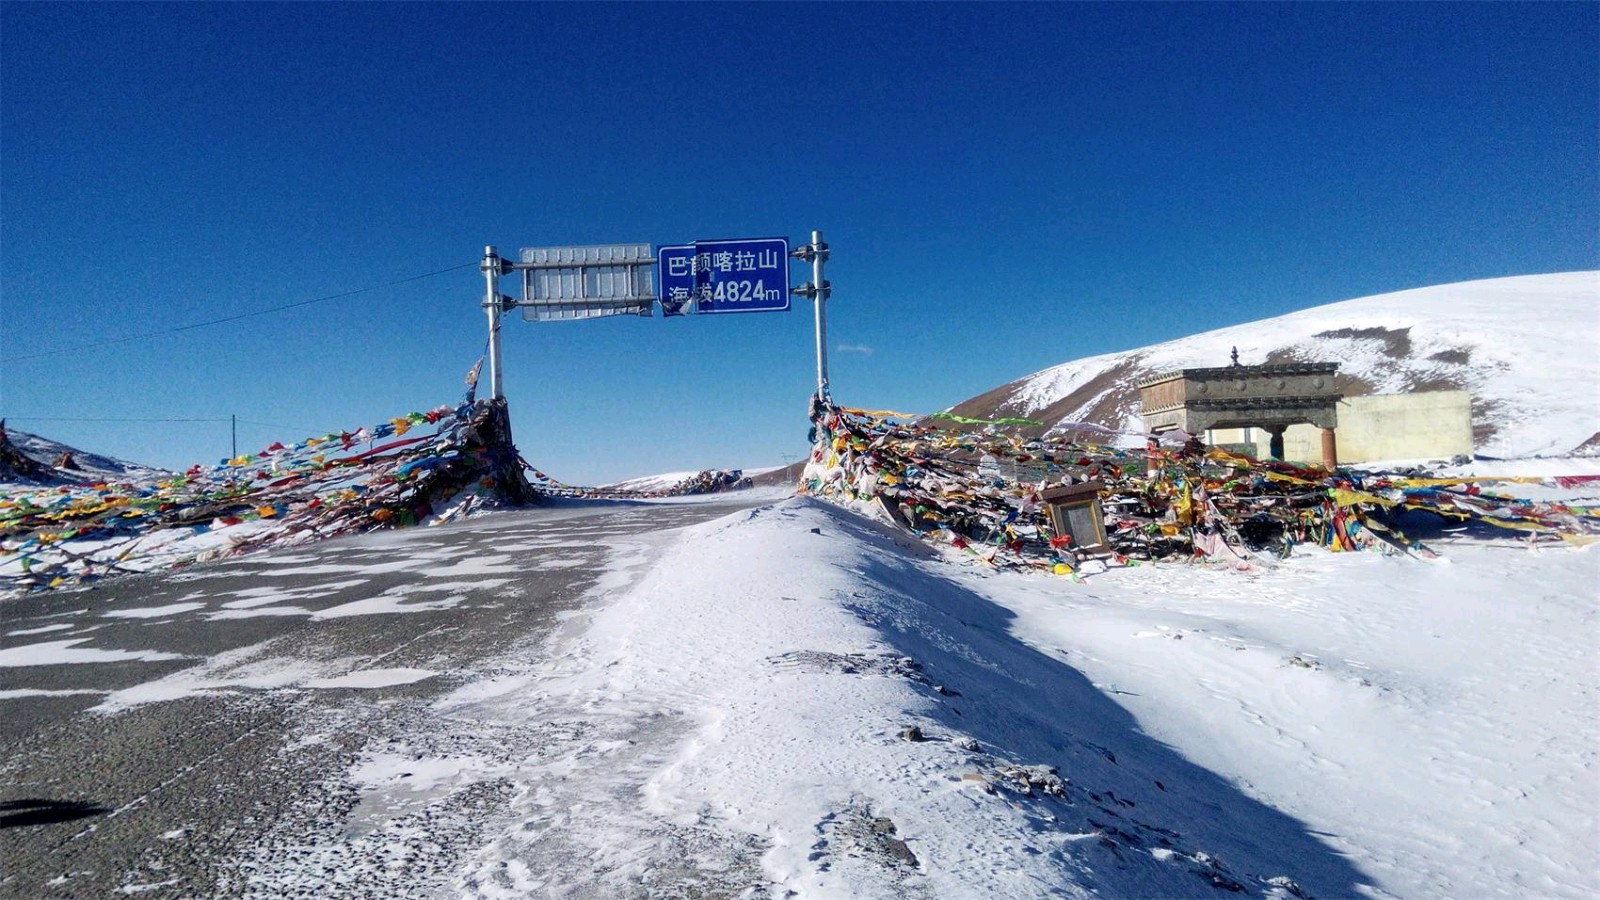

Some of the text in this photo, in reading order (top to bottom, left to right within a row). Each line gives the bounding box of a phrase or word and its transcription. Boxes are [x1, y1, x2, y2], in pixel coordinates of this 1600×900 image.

[668, 249, 777, 276] 巴颜喀拉山
